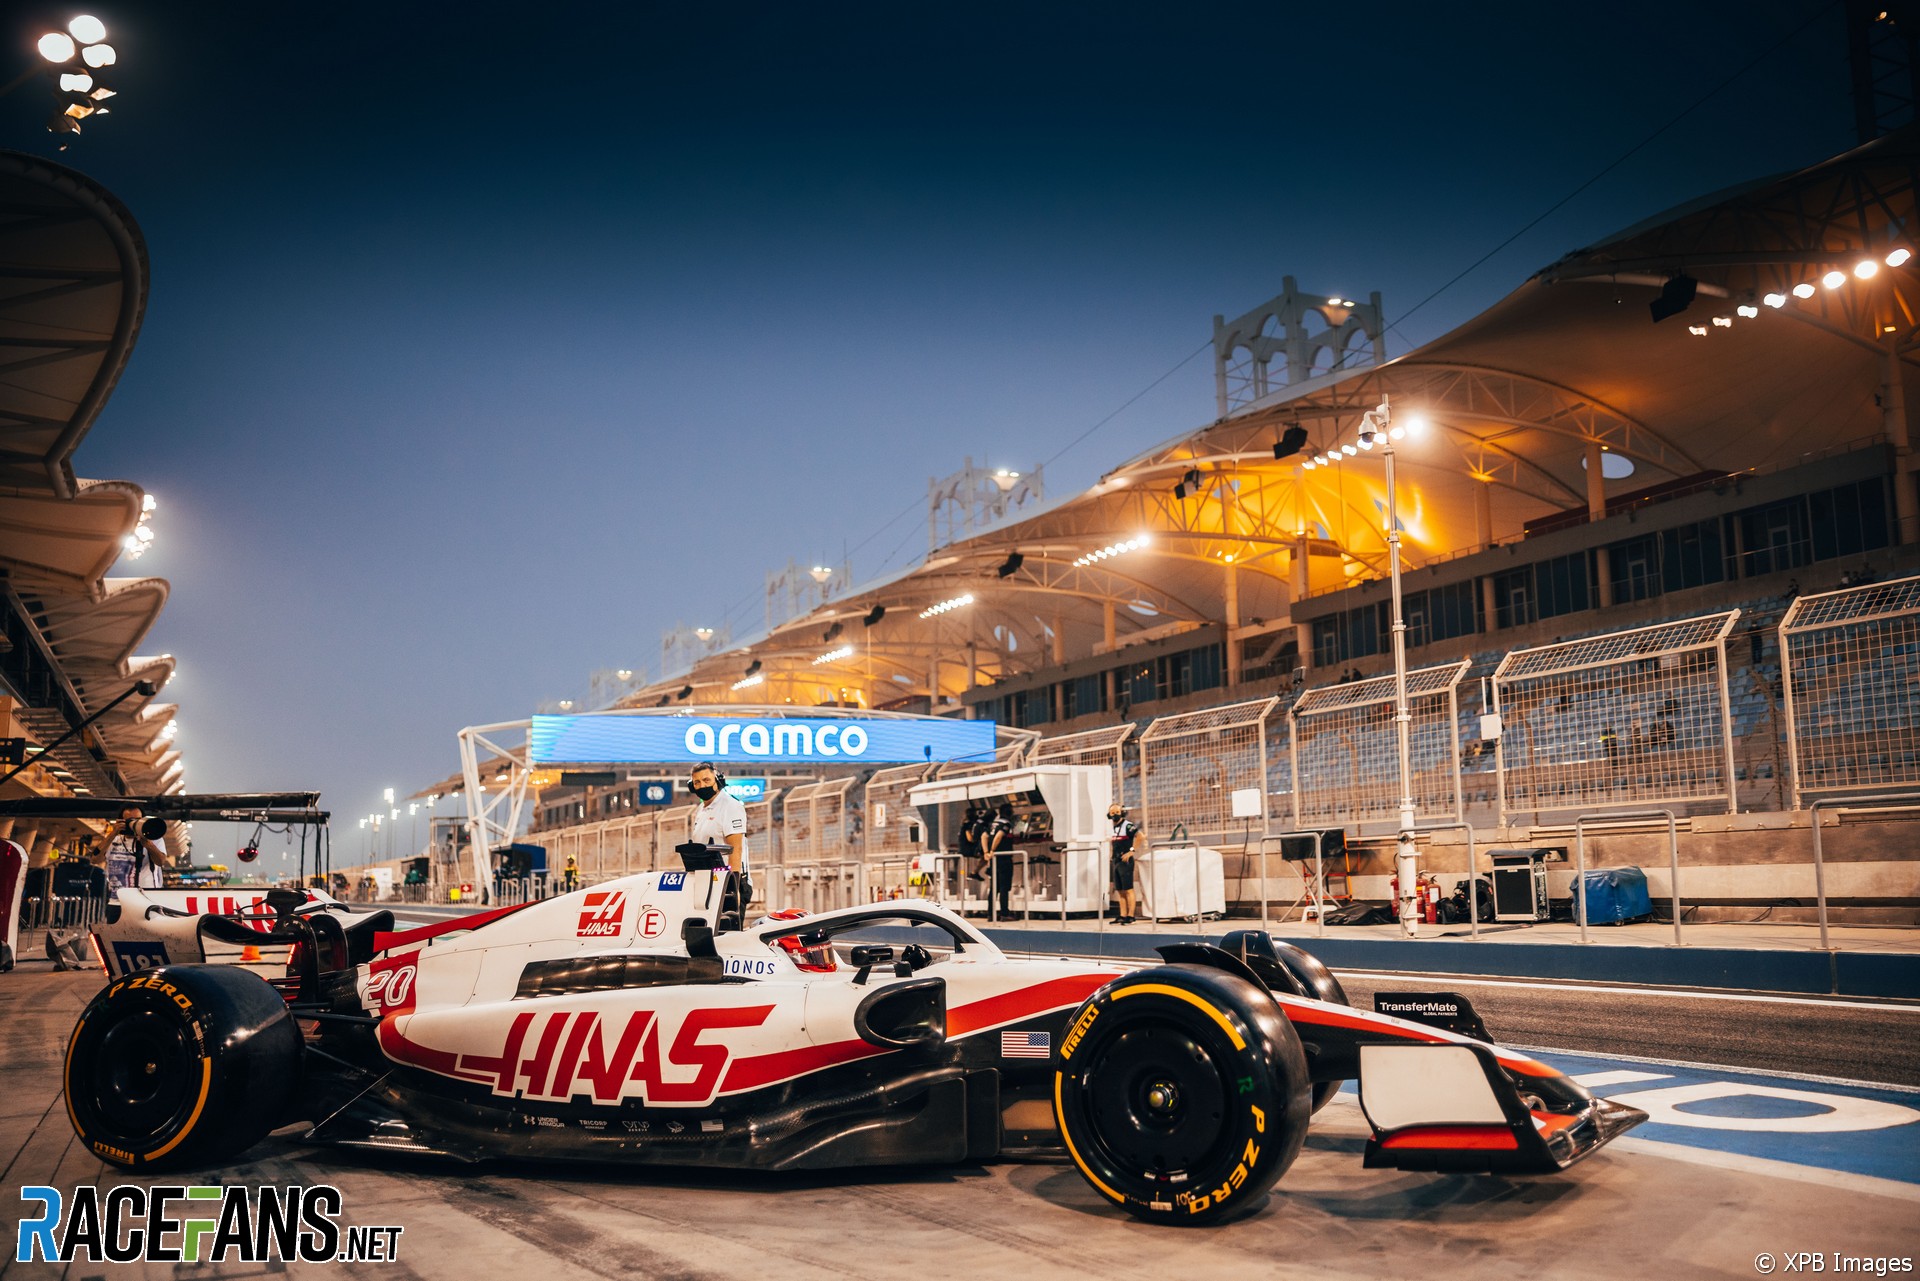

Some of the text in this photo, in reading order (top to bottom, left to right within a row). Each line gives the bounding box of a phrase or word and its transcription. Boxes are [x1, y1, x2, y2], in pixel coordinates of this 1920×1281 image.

[685, 723, 868, 756] aramco
[663, 874, 682, 886] 1&1
[577, 922, 622, 936] HAAS
[644, 913, 659, 935] E
[724, 960, 775, 974] IONOS
[109, 977, 193, 1009] P ZERO
[361, 965, 416, 1010] 20
[1380, 1002, 1457, 1012] TransferMate
[1060, 1003, 1099, 1060] PIRELLI
[460, 1004, 777, 1102] HAAS
[538, 1120, 565, 1128] ARMOUR
[94, 1141, 135, 1165] PIRELLI
[1189, 1104, 1265, 1214] P ZERO
